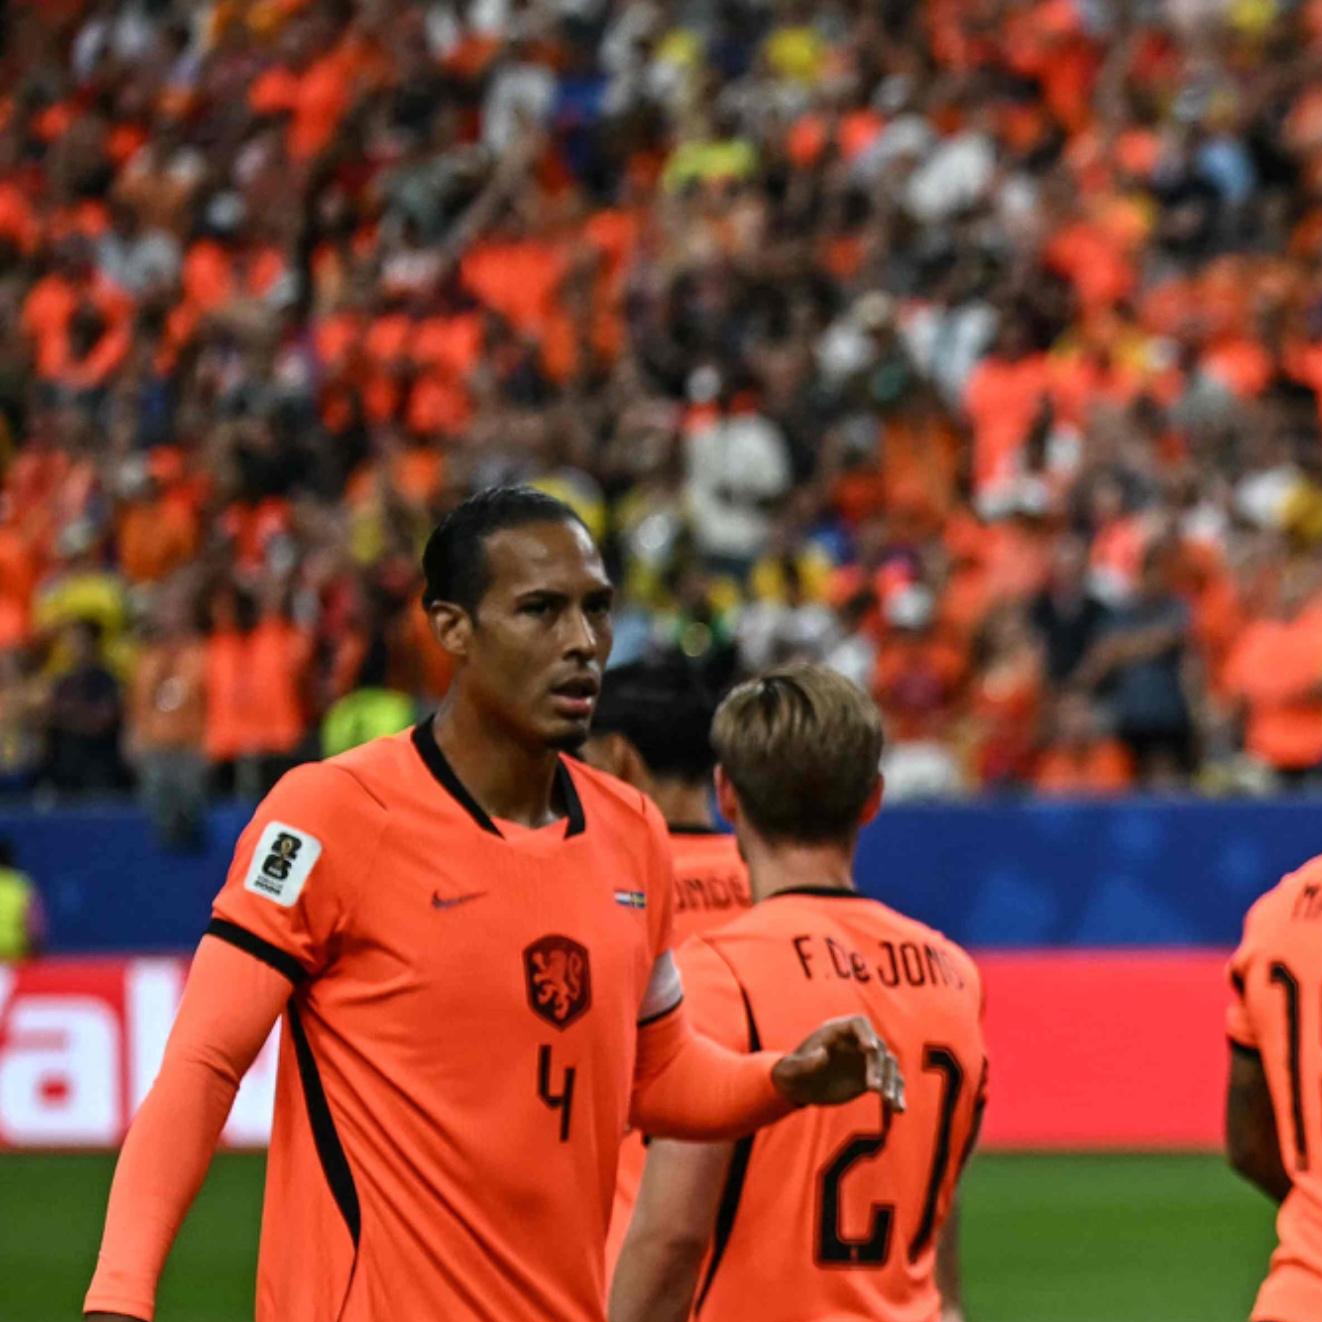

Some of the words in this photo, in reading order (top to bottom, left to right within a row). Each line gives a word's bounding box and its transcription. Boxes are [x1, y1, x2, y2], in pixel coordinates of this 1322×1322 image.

[877, 940, 965, 989] JON
[538, 1044, 576, 1143] 4
[813, 1042, 963, 1271] 21
